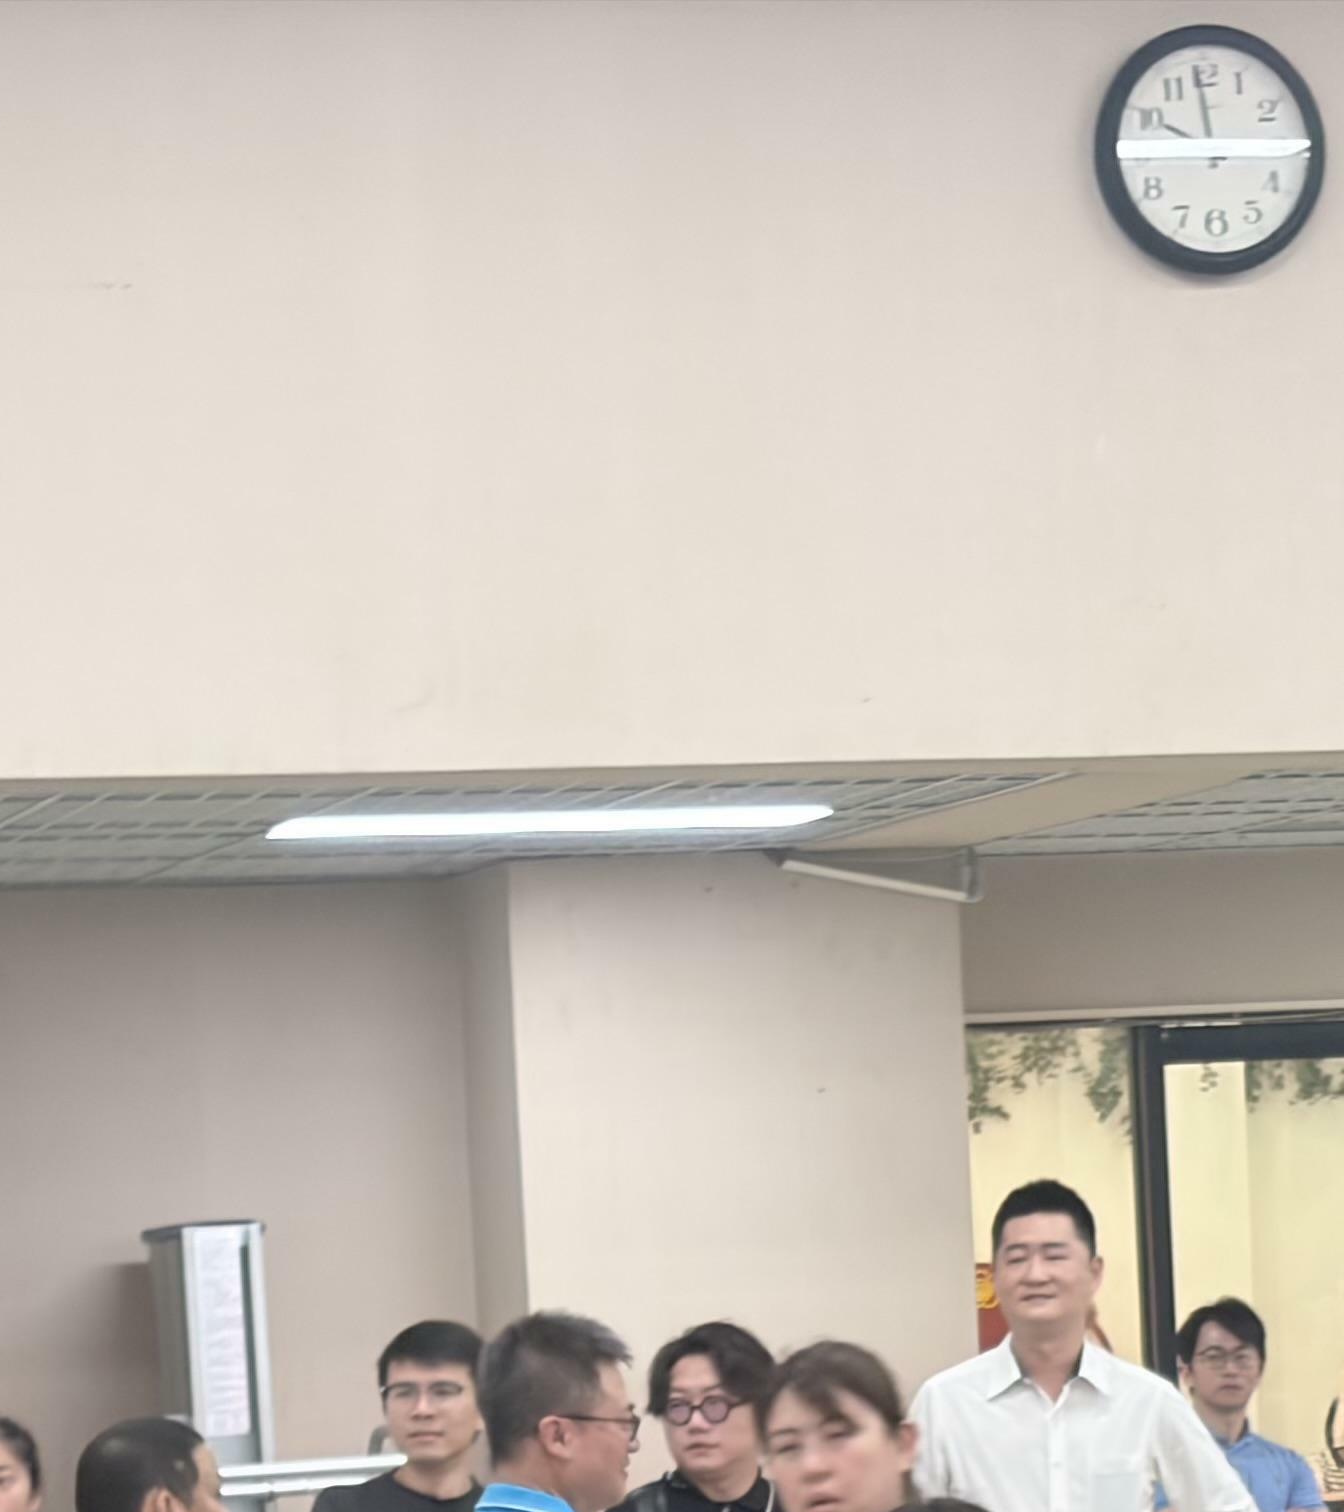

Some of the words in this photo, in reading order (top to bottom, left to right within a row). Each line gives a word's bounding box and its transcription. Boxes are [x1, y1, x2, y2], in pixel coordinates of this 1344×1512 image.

[1163, 76, 1184, 101] 11
[1233, 72, 1244, 95] 1
[1137, 107, 1164, 130] 10
[1257, 100, 1278, 122] 2
[1143, 176, 1163, 200] 8
[1261, 170, 1280, 193] 4
[1171, 205, 1190, 229] 7
[1204, 209, 1229, 236] 6
[1243, 200, 1263, 224] 5
